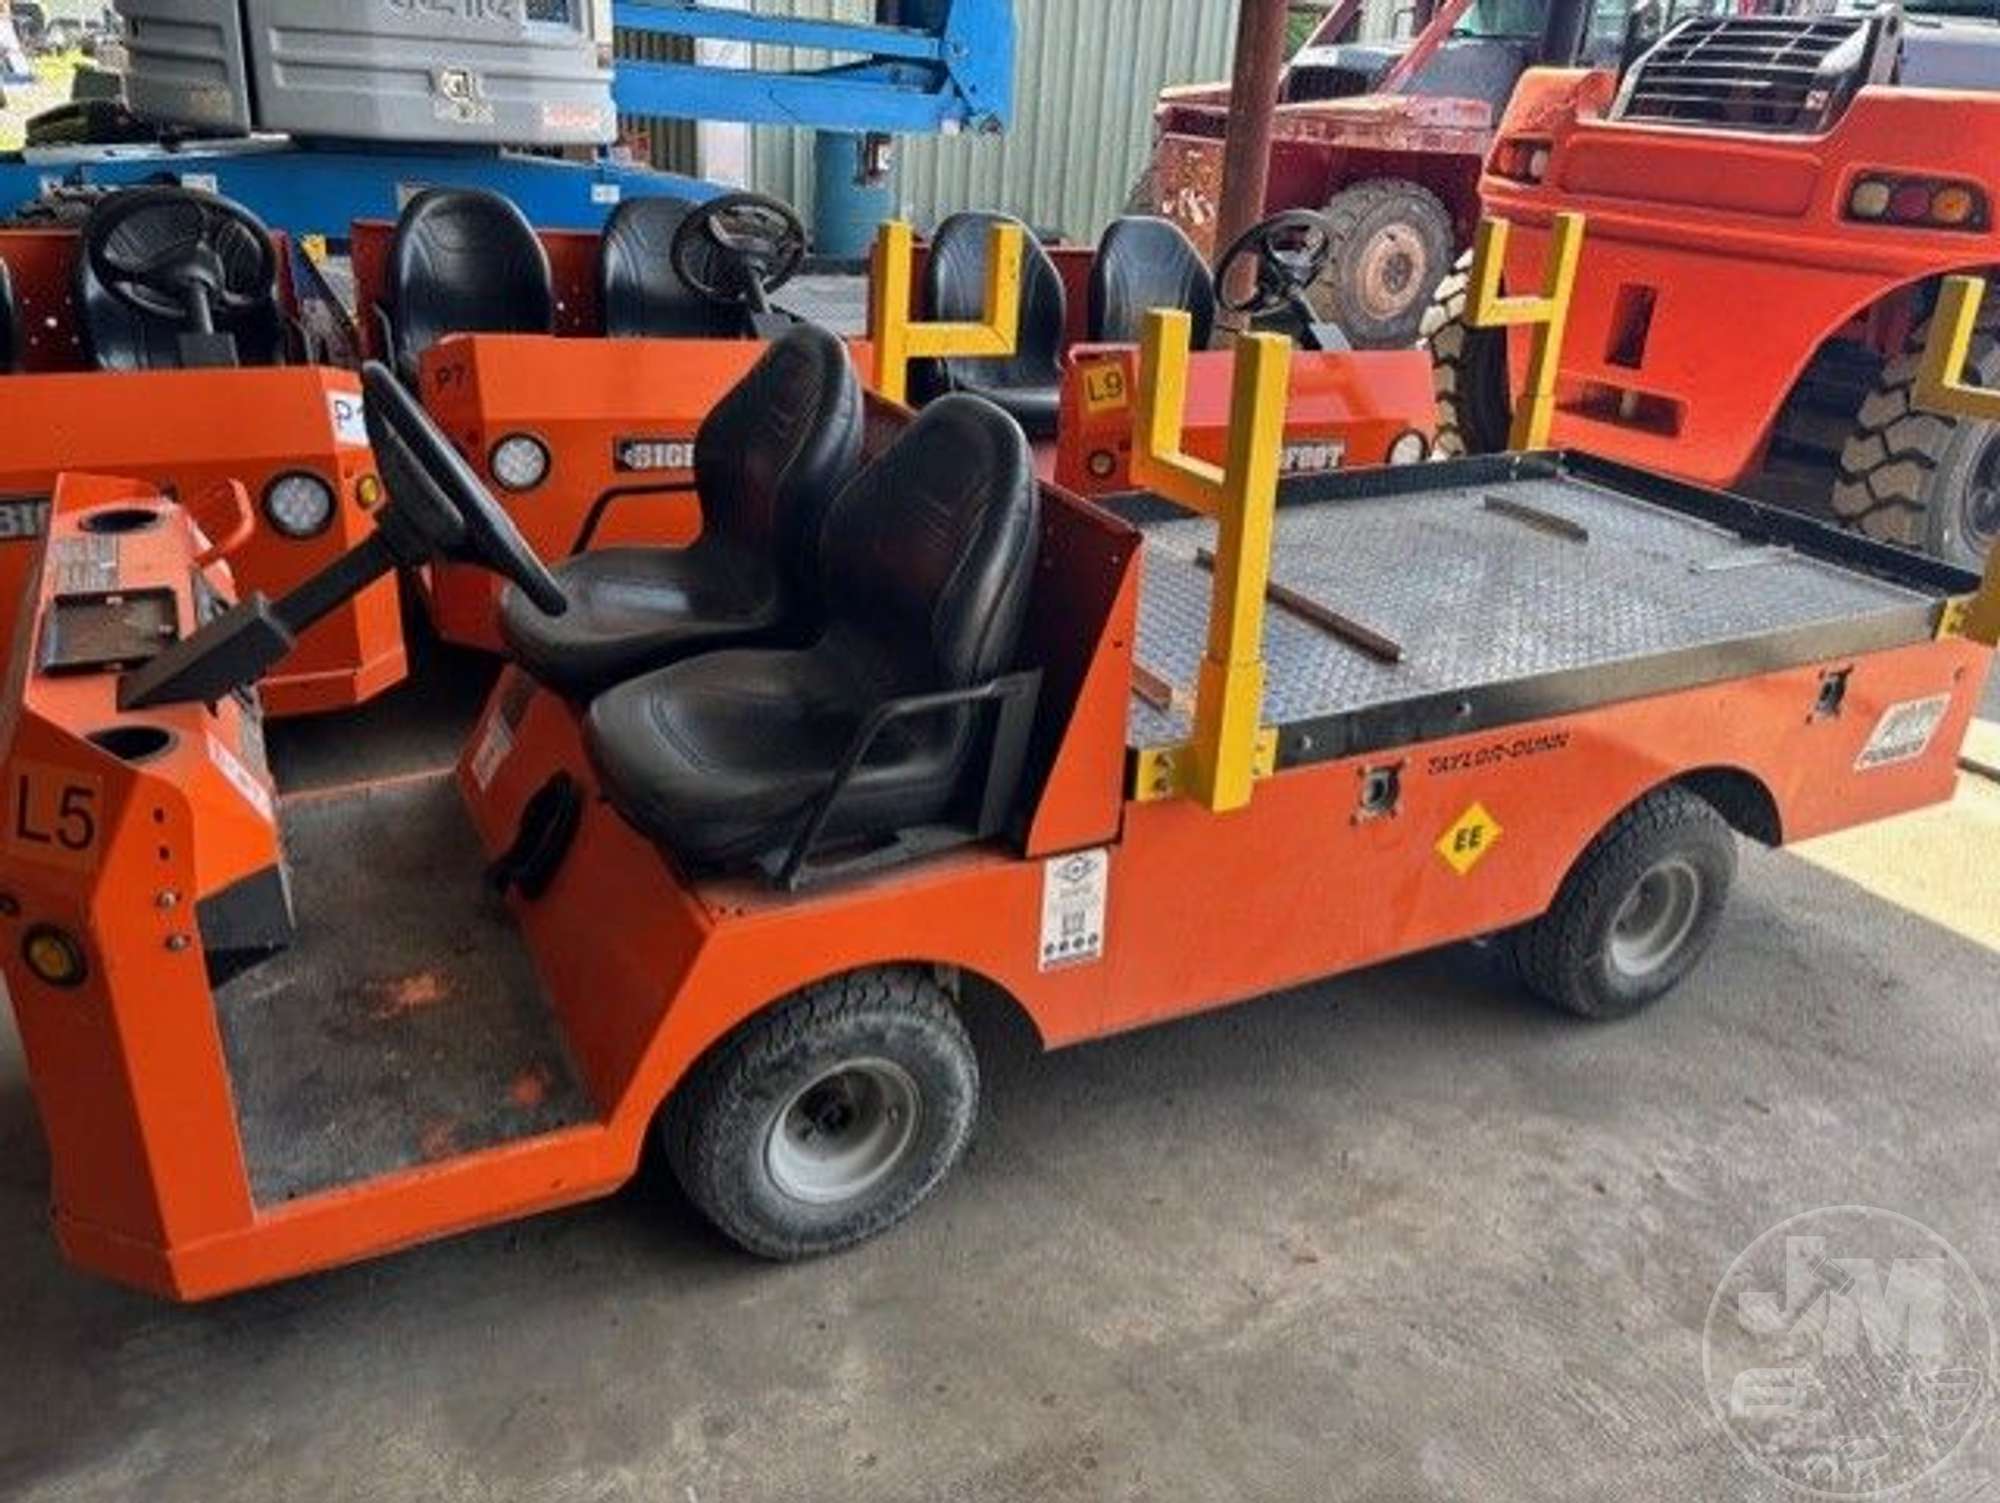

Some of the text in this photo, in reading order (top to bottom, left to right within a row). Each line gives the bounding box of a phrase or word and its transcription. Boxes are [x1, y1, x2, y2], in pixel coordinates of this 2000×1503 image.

[1087, 371, 1122, 401] L9
[334, 400, 362, 429] P
[1428, 731, 1570, 775] TAYLOR-DUNN
[18, 776, 95, 851] L5
[1453, 825, 1483, 852] EE
